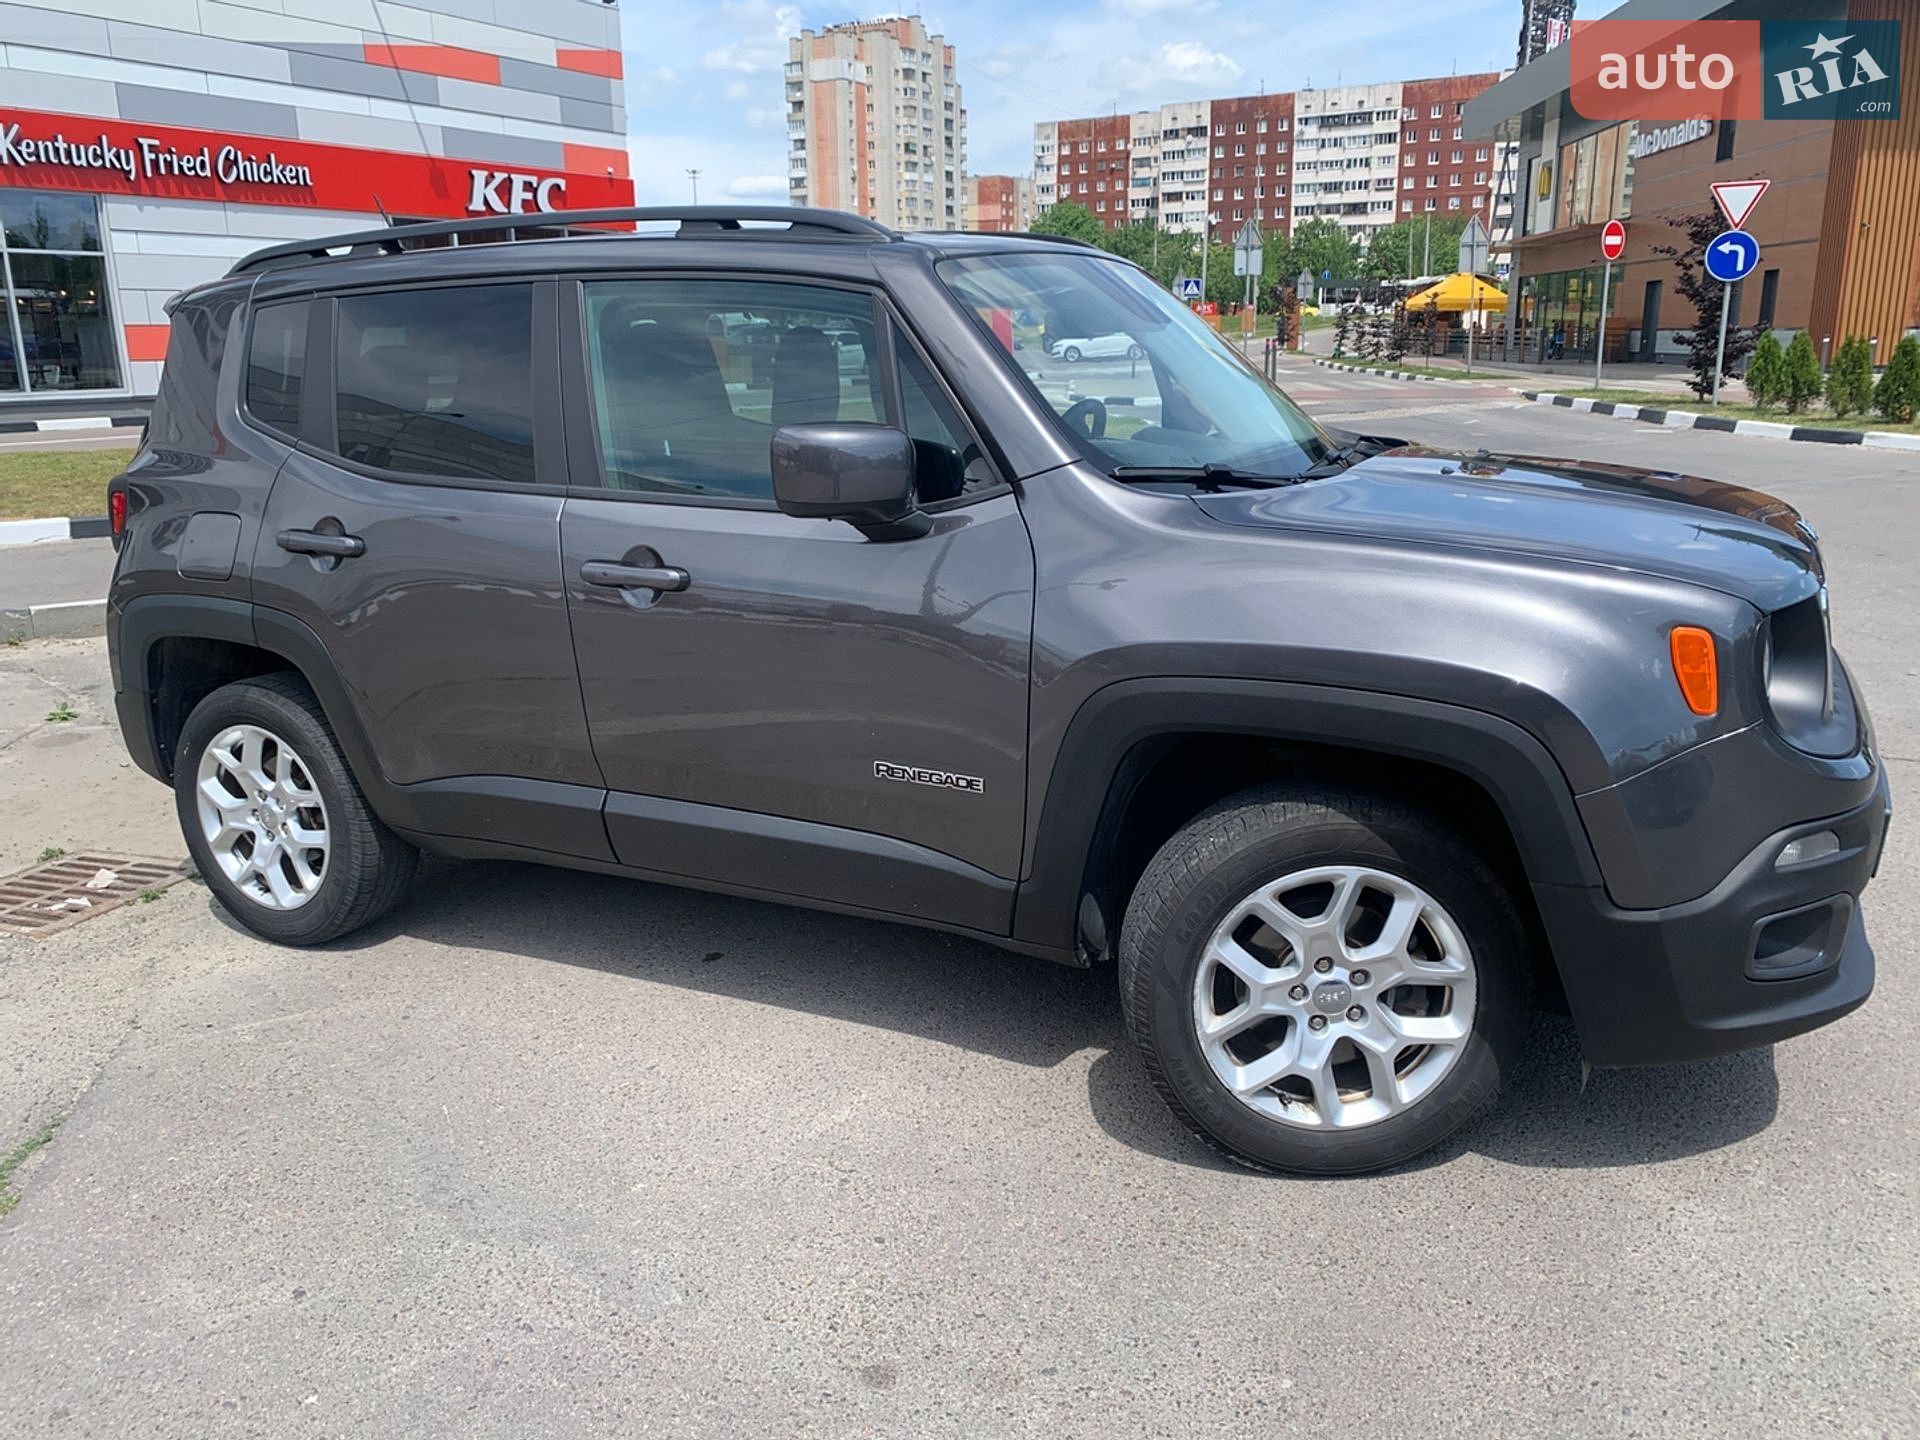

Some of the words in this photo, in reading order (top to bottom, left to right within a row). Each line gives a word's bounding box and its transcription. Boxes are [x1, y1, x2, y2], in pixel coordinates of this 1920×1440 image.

[0, 123, 136, 181] Kentucky
[137, 137, 212, 179] Fried
[217, 145, 313, 187] Chicken
[468, 168, 566, 214] KFC
[873, 760, 985, 794] RENEGADE
